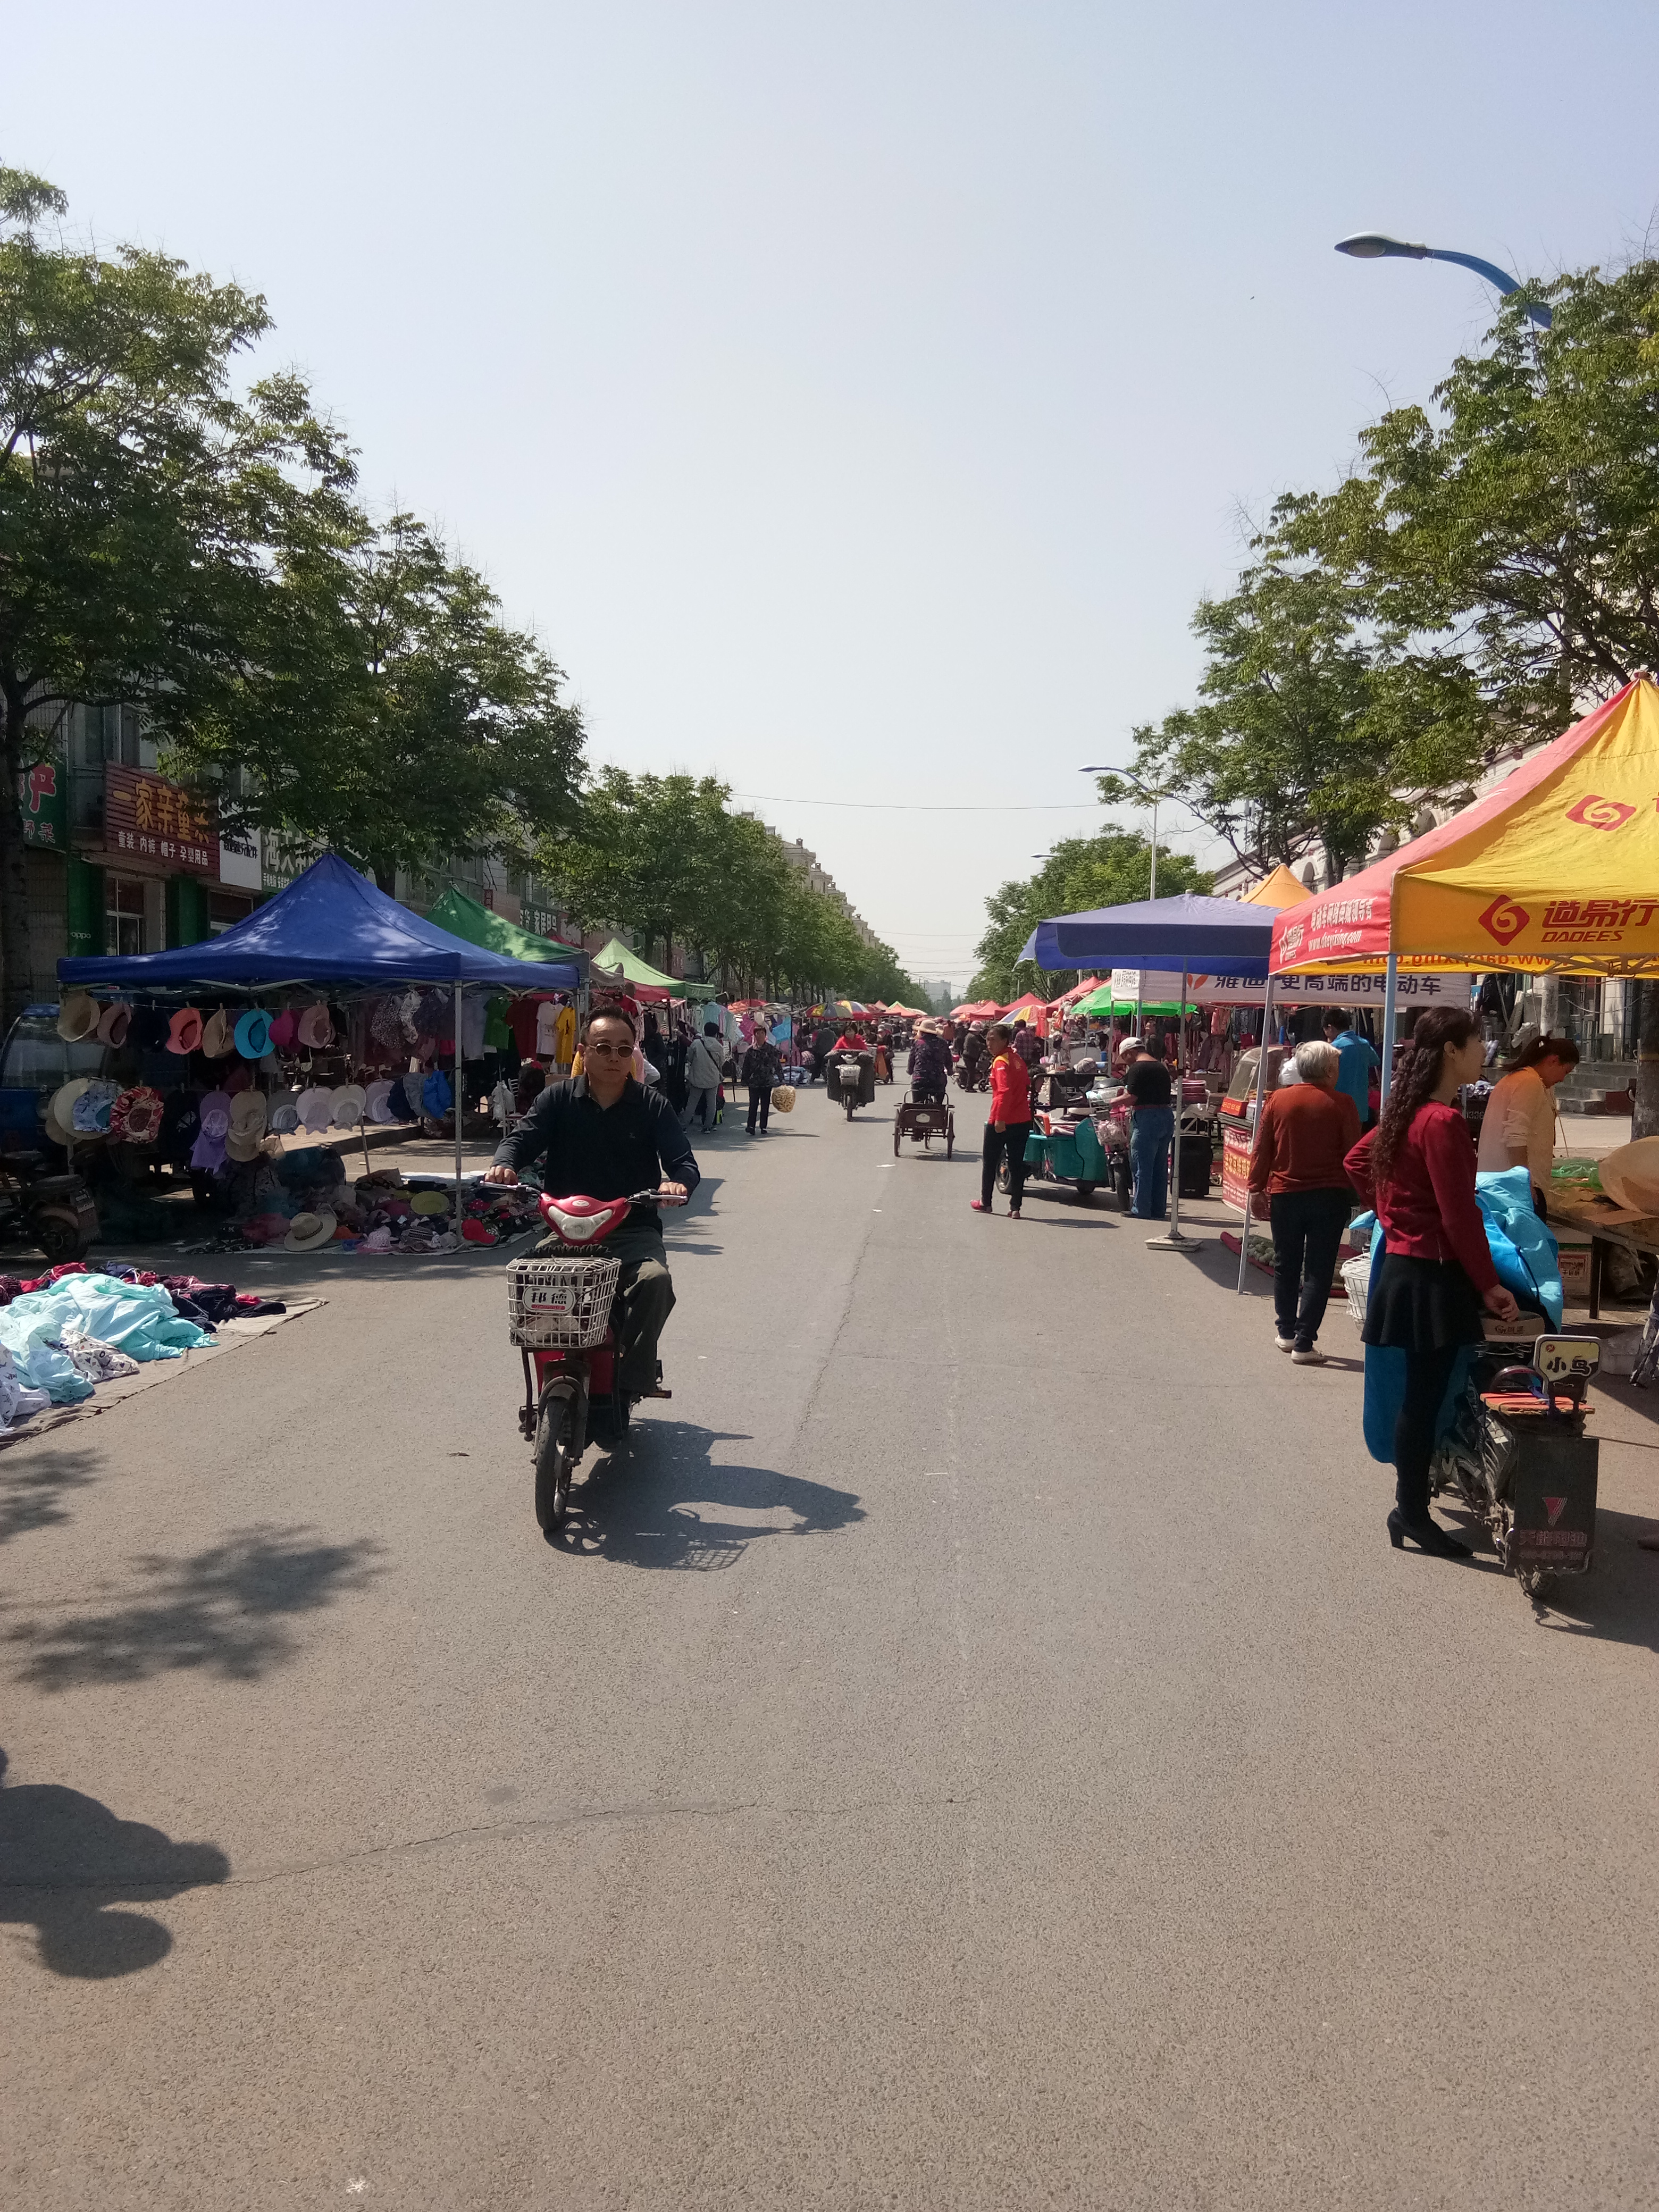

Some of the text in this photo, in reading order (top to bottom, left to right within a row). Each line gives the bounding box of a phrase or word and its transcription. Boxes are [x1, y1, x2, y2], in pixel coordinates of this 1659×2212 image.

[118, 831, 134, 850] 童装
[140, 836, 156, 854] 内裤
[161, 840, 176, 858] 帽子
[180, 845, 208, 867] 孕婴用品
[1542, 899, 1659, 928] 道易行
[1546, 1355, 1591, 1377] 小鸟
